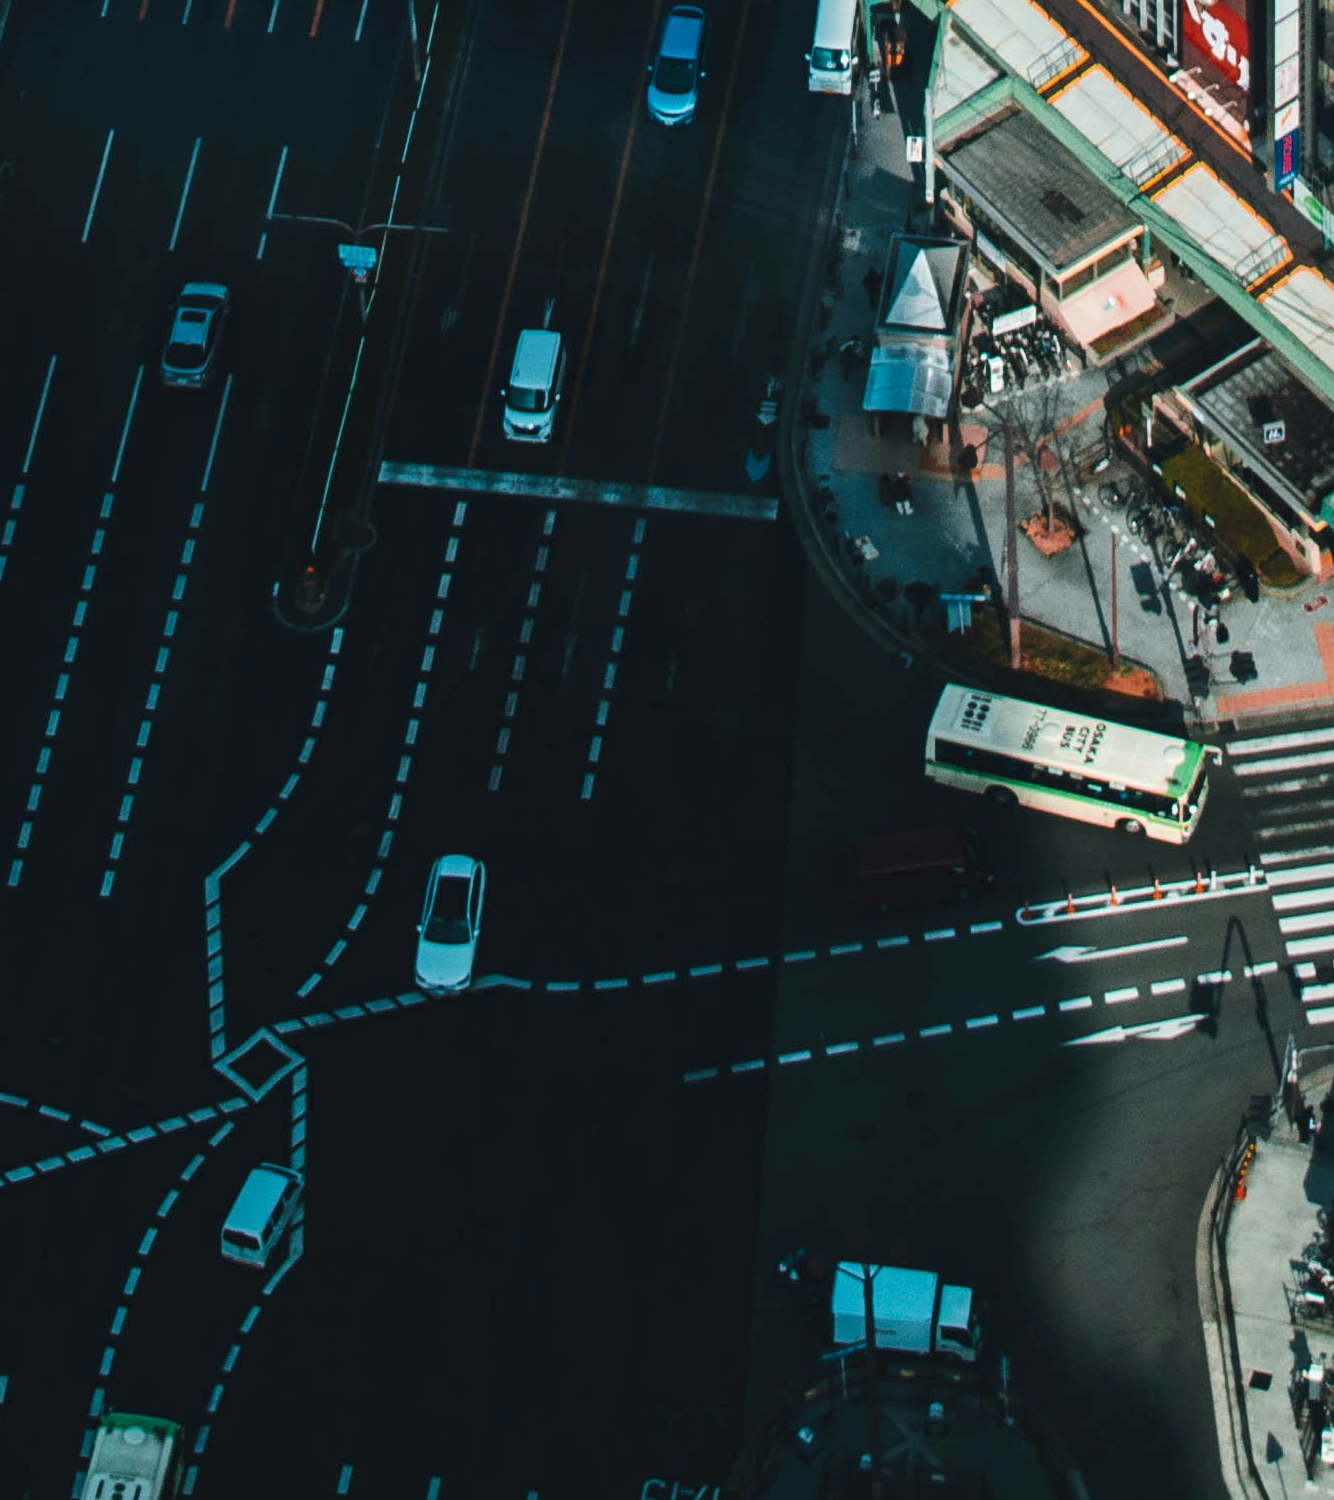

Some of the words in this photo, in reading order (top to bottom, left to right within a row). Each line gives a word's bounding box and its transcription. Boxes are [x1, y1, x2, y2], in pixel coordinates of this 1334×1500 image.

[1059, 725, 1077, 749] BUS
[1073, 726, 1091, 754] CITY
[1083, 723, 1107, 765] OSAKA
